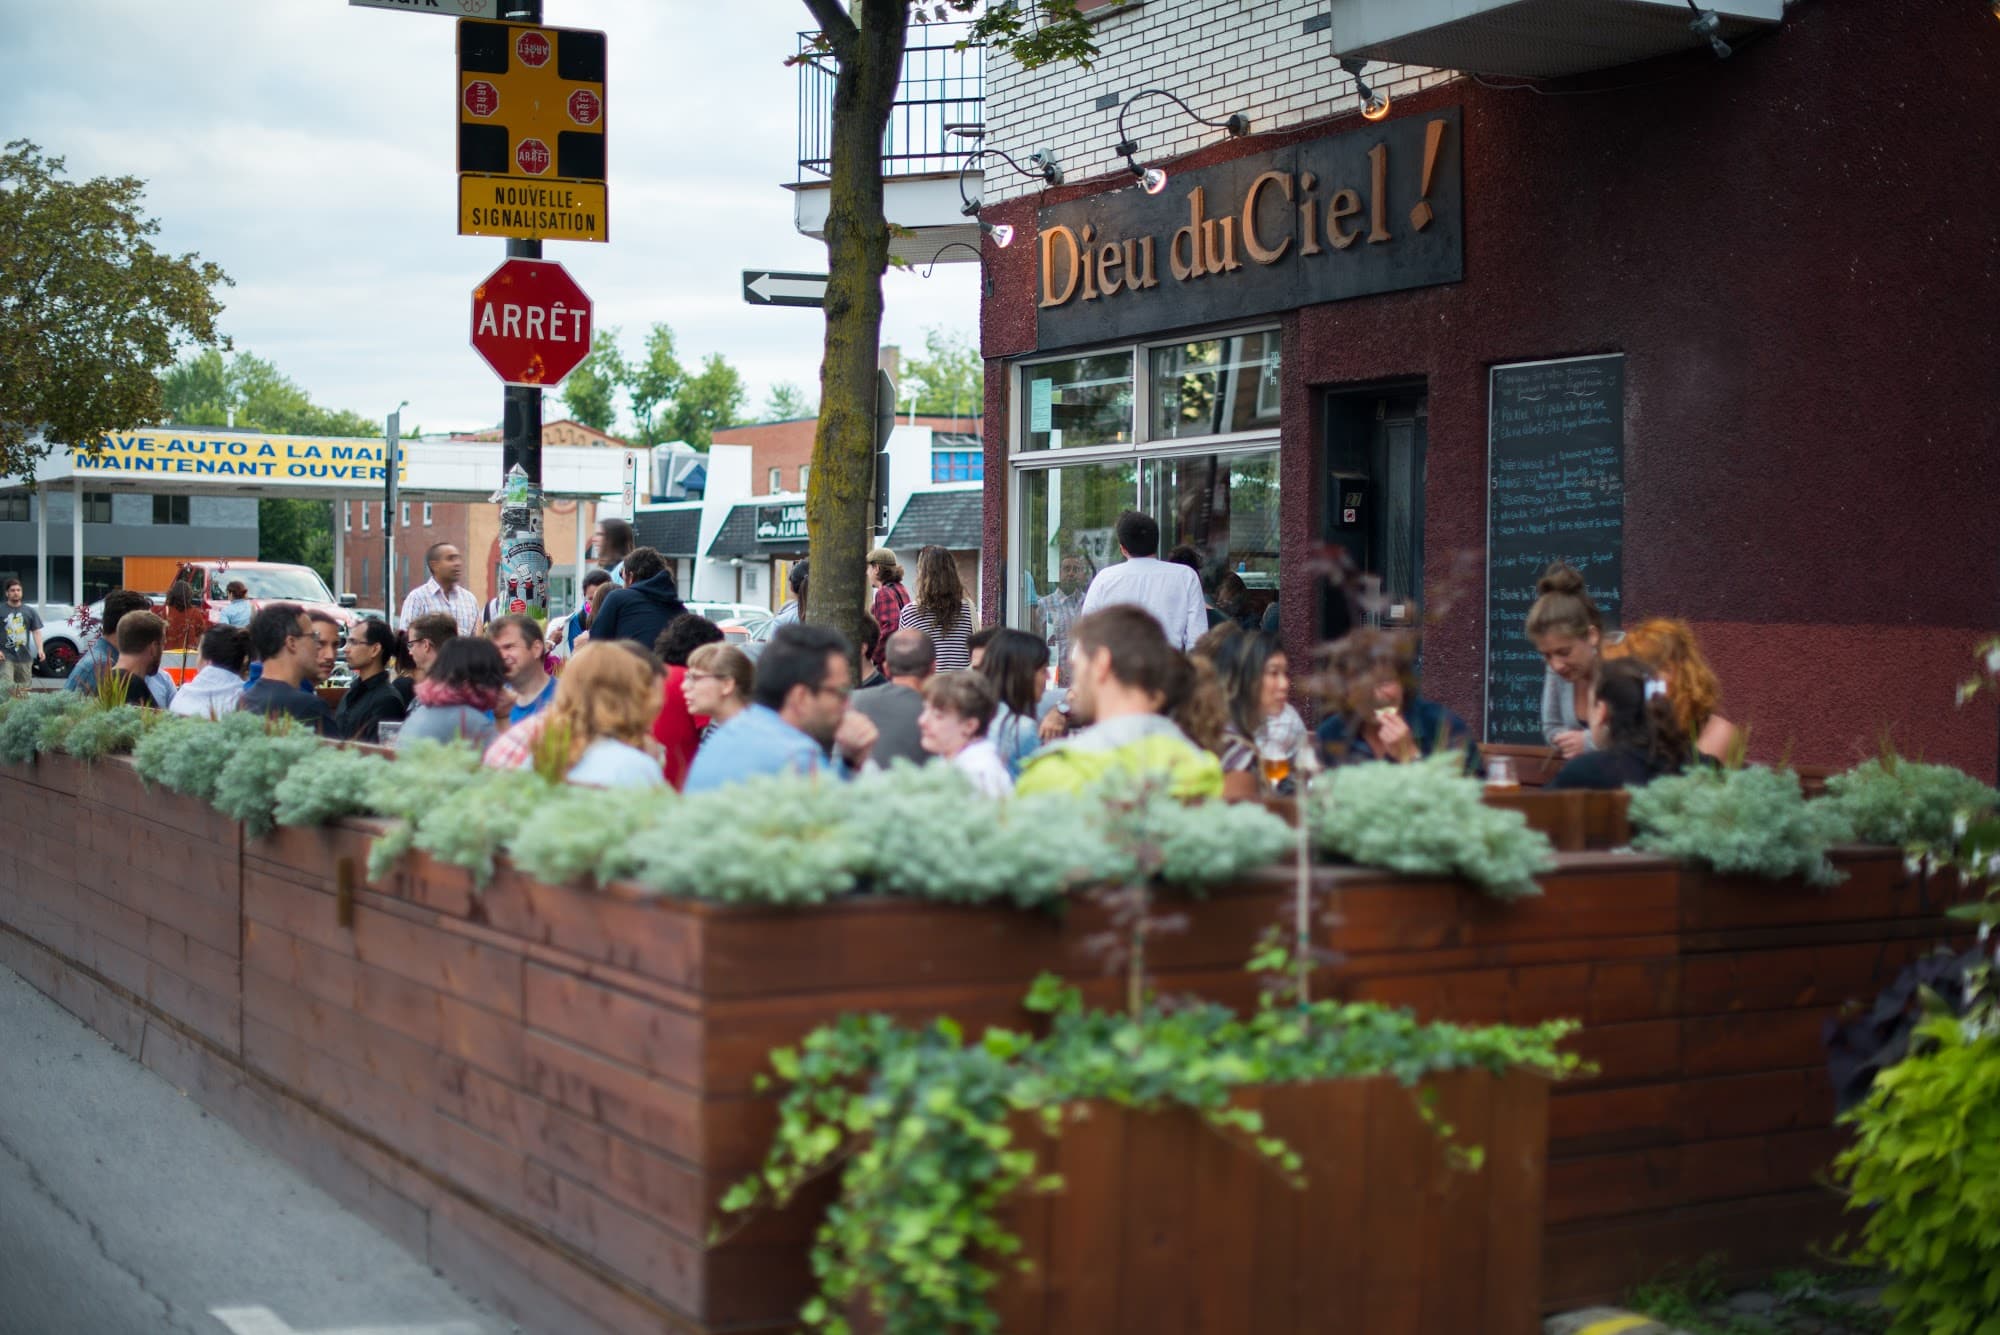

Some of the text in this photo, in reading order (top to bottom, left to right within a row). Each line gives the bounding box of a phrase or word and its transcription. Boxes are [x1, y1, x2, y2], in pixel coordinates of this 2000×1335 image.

[495, 187, 573, 209] NOUVELLE
[472, 208, 596, 232] SIGNALISATION
[1038, 224, 1159, 309] Dieu
[478, 301, 587, 343] ARRÊT
[287, 444, 323, 459] LA
[76, 454, 277, 476] MAINTENANT
